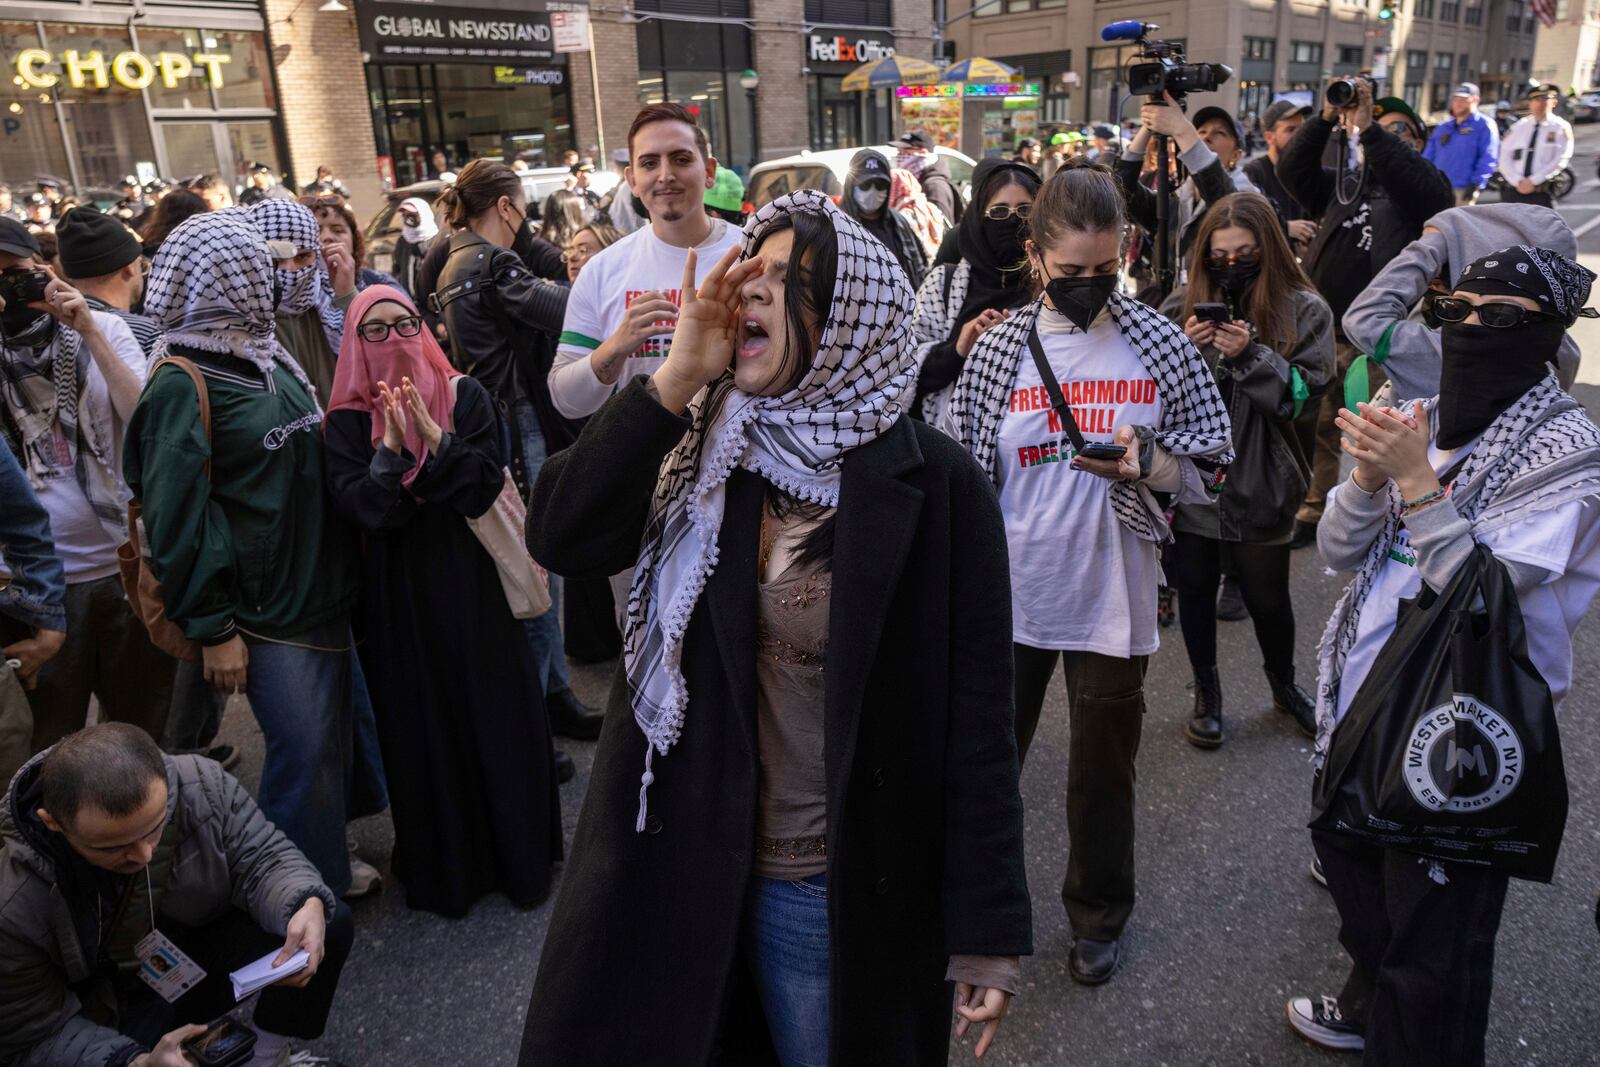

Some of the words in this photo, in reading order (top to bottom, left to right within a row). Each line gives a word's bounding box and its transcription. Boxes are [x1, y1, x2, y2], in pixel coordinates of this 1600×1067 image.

[373, 15, 446, 38] GLOBAL
[447, 20, 552, 42] NEWSSTAND
[810, 35, 857, 61] FedEx
[16, 48, 232, 90] CHOPT
[525, 69, 564, 85] PHOTO
[1009, 385, 1052, 412] FREE
[1047, 408, 1115, 434] KALIL!
[1017, 440, 1060, 468] FREE
[1502, 746, 1518, 787] NYC
